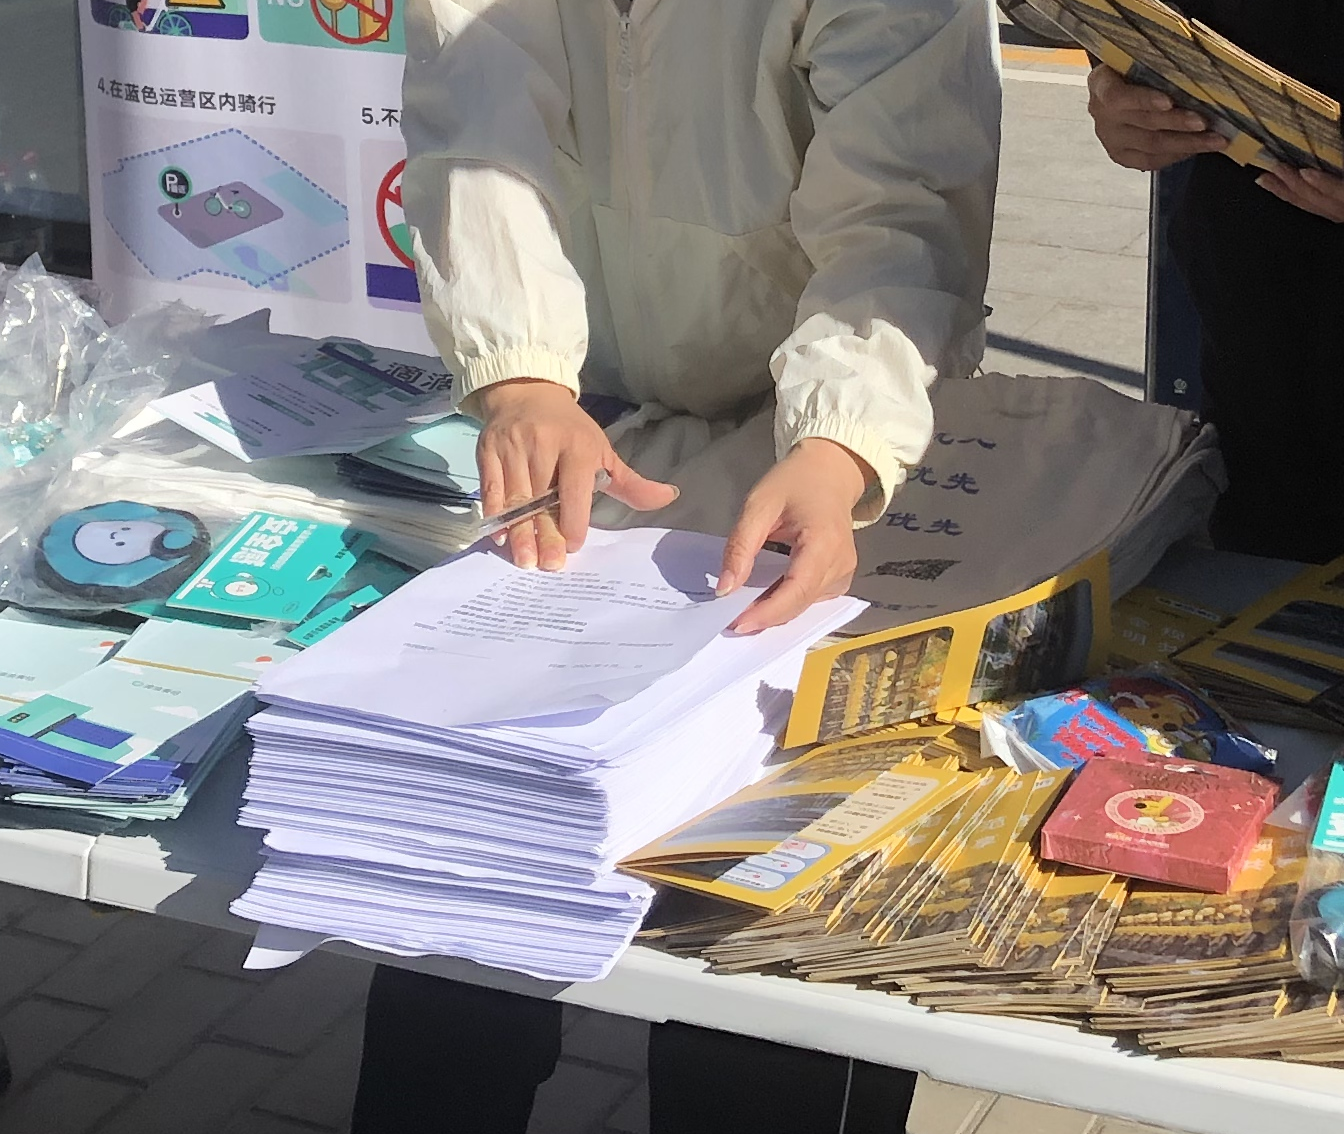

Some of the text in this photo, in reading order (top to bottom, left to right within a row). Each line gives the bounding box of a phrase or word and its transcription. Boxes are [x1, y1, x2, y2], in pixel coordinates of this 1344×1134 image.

[97, 76, 402, 128] 4.在蓝色运营区内骑行 5.不
